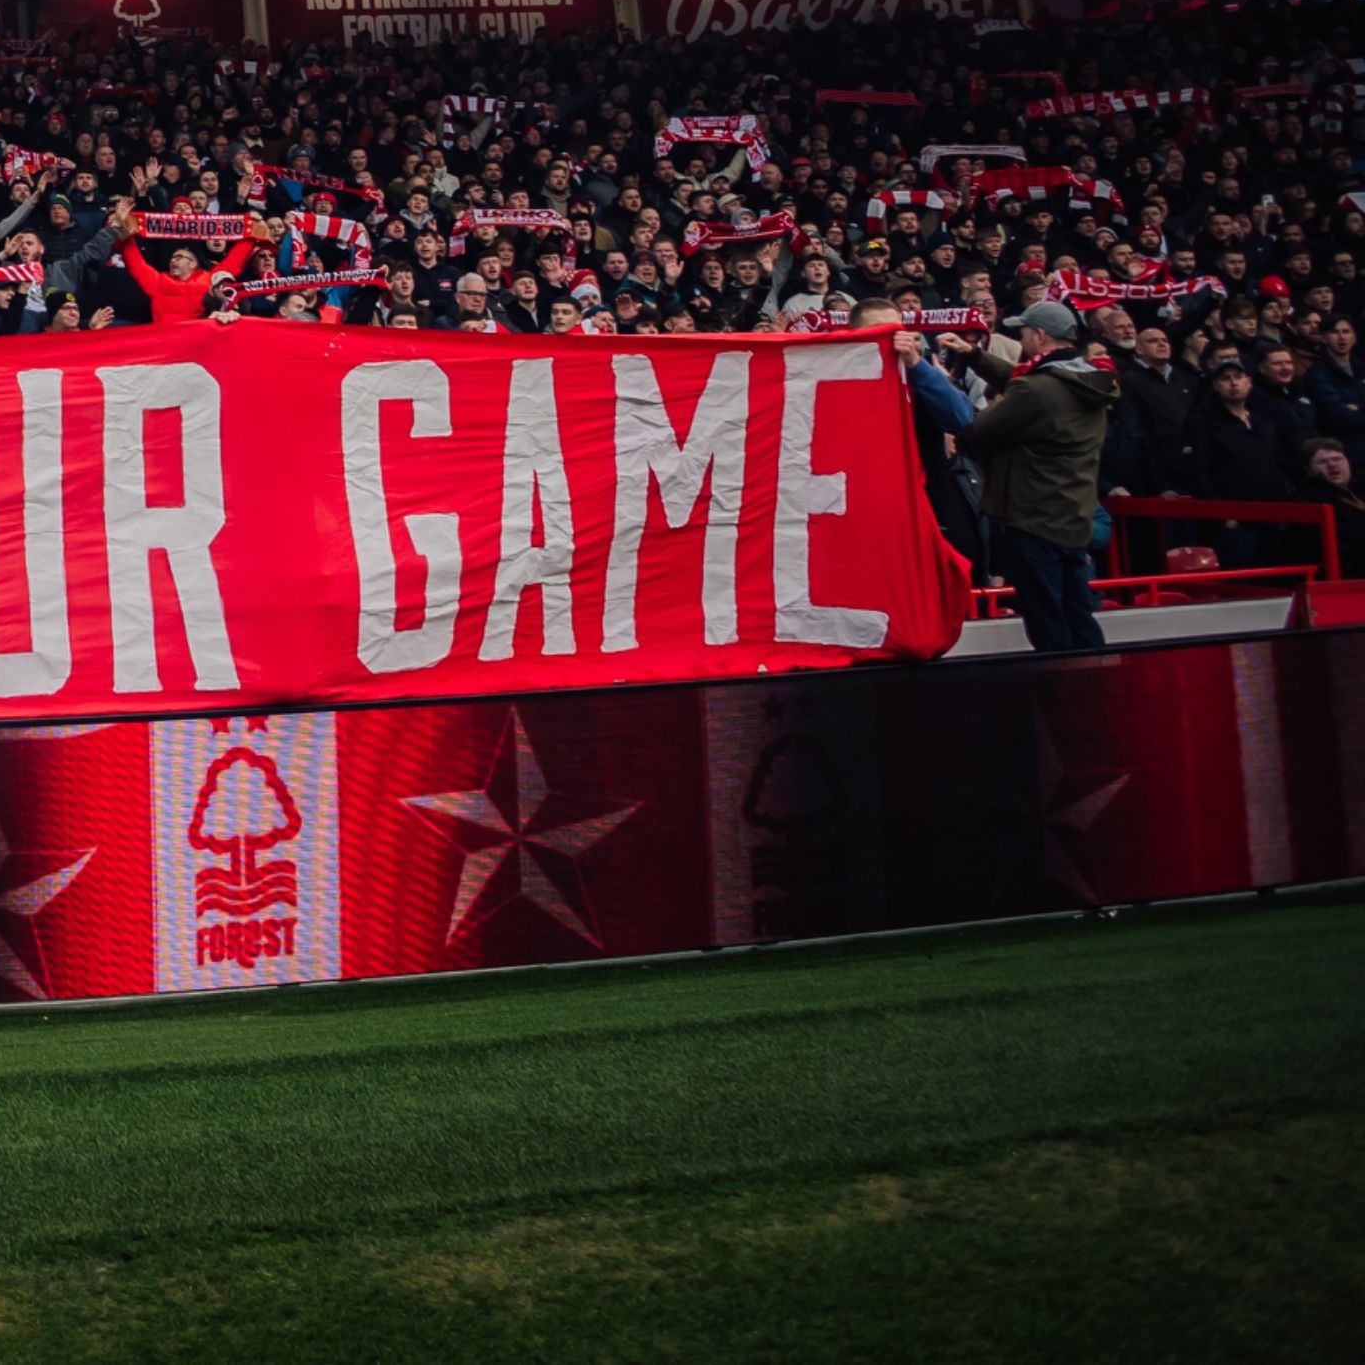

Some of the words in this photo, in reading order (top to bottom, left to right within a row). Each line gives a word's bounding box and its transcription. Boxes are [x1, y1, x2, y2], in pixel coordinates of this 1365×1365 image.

[147, 220, 217, 235] MADRID
[222, 219, 245, 235] 80
[243, 272, 331, 291] NOTTINGHAM
[921, 308, 970, 324] FOREST
[341, 343, 889, 673] GAME
